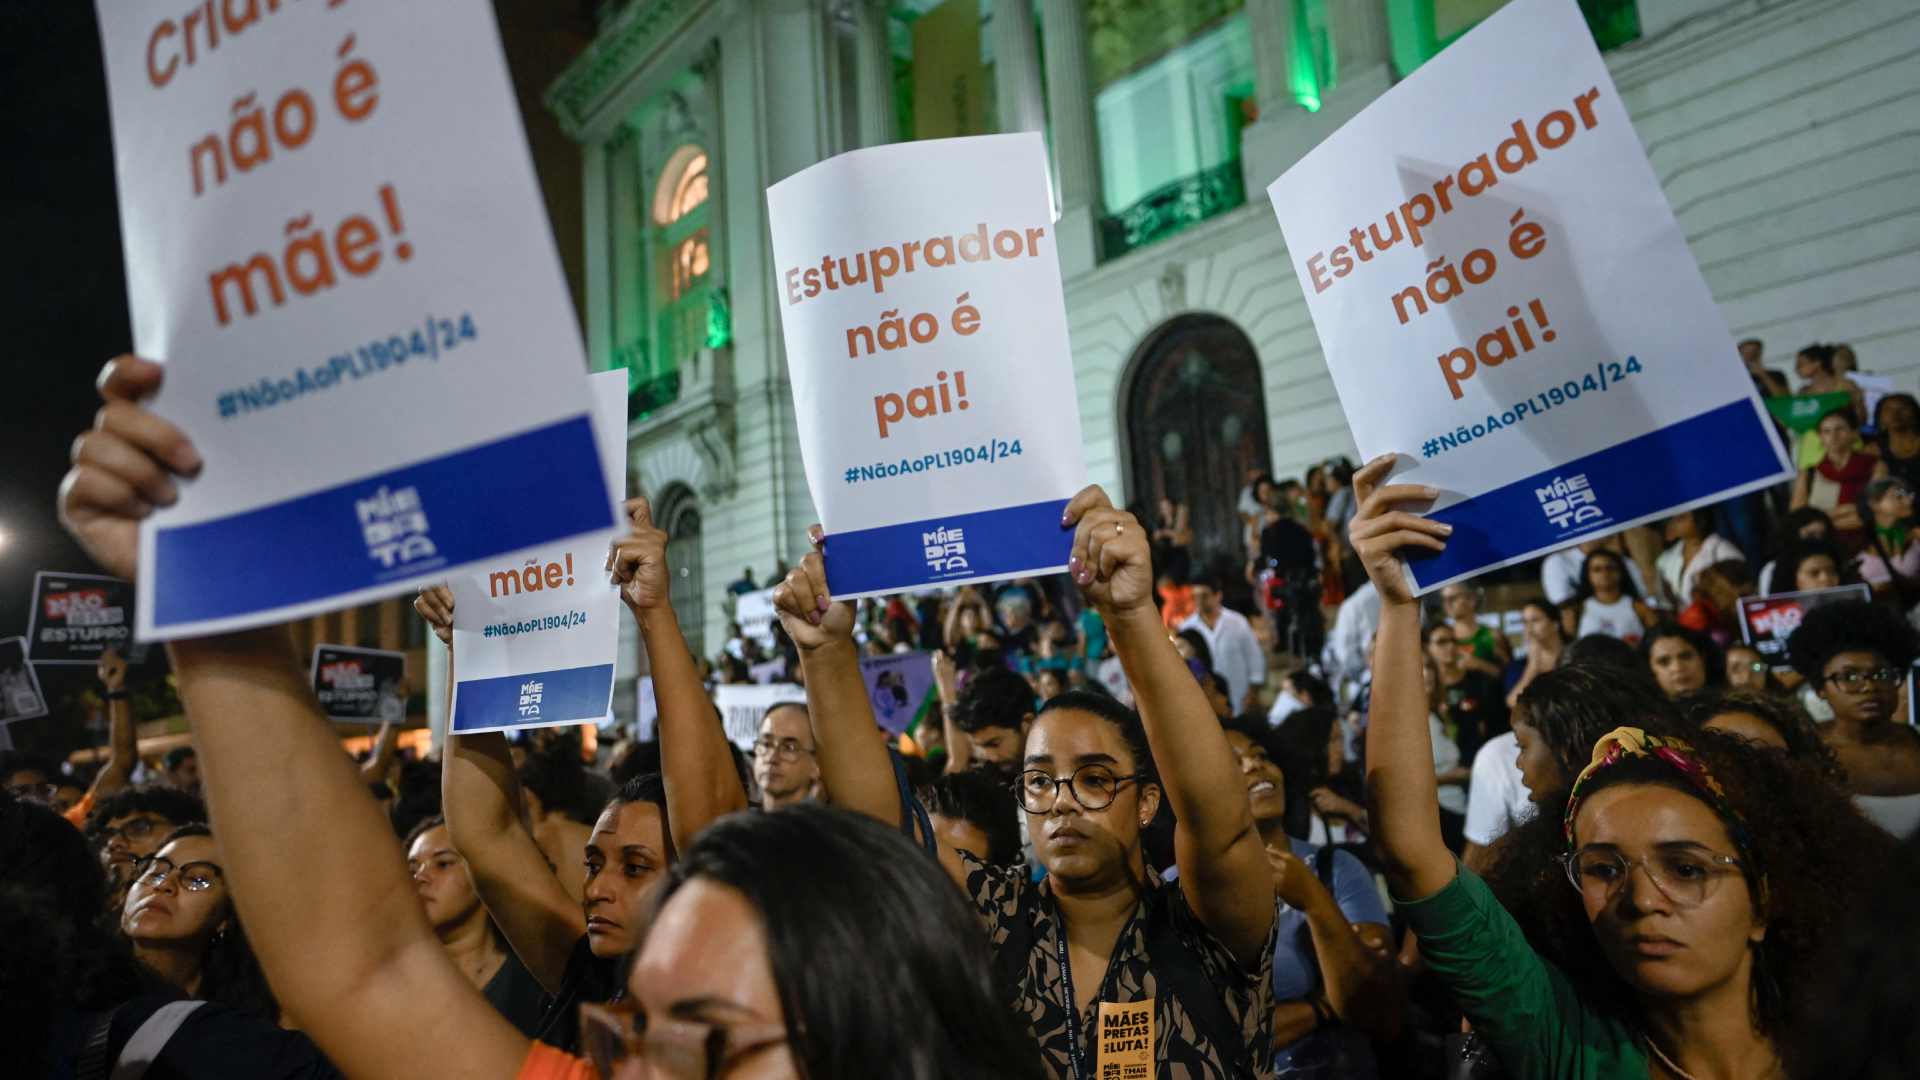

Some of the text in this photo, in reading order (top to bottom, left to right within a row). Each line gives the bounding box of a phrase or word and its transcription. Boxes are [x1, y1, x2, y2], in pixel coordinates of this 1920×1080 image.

[190, 32, 379, 197] não é
[1306, 86, 1600, 295] Estuprador
[209, 184, 413, 327] mãe!
[785, 223, 1045, 305] Estuprador
[1391, 207, 1547, 325] não é
[847, 292, 981, 358] não é
[1437, 297, 1557, 400] pai!
[217, 311, 477, 419] #NãoAoPL1904/24
[874, 370, 970, 438] pai!
[1421, 355, 1643, 459] #NãoAoPL1904/24
[843, 438, 1024, 484] #NãoAoPL1904/24
[489, 552, 576, 598] mãe!
[483, 610, 587, 638] #NãoAoPL1904/24
[1104, 1010, 1149, 1027] MÃES
[1104, 1025, 1149, 1039] PRETAS
[1111, 1038, 1149, 1053] LUTA!
